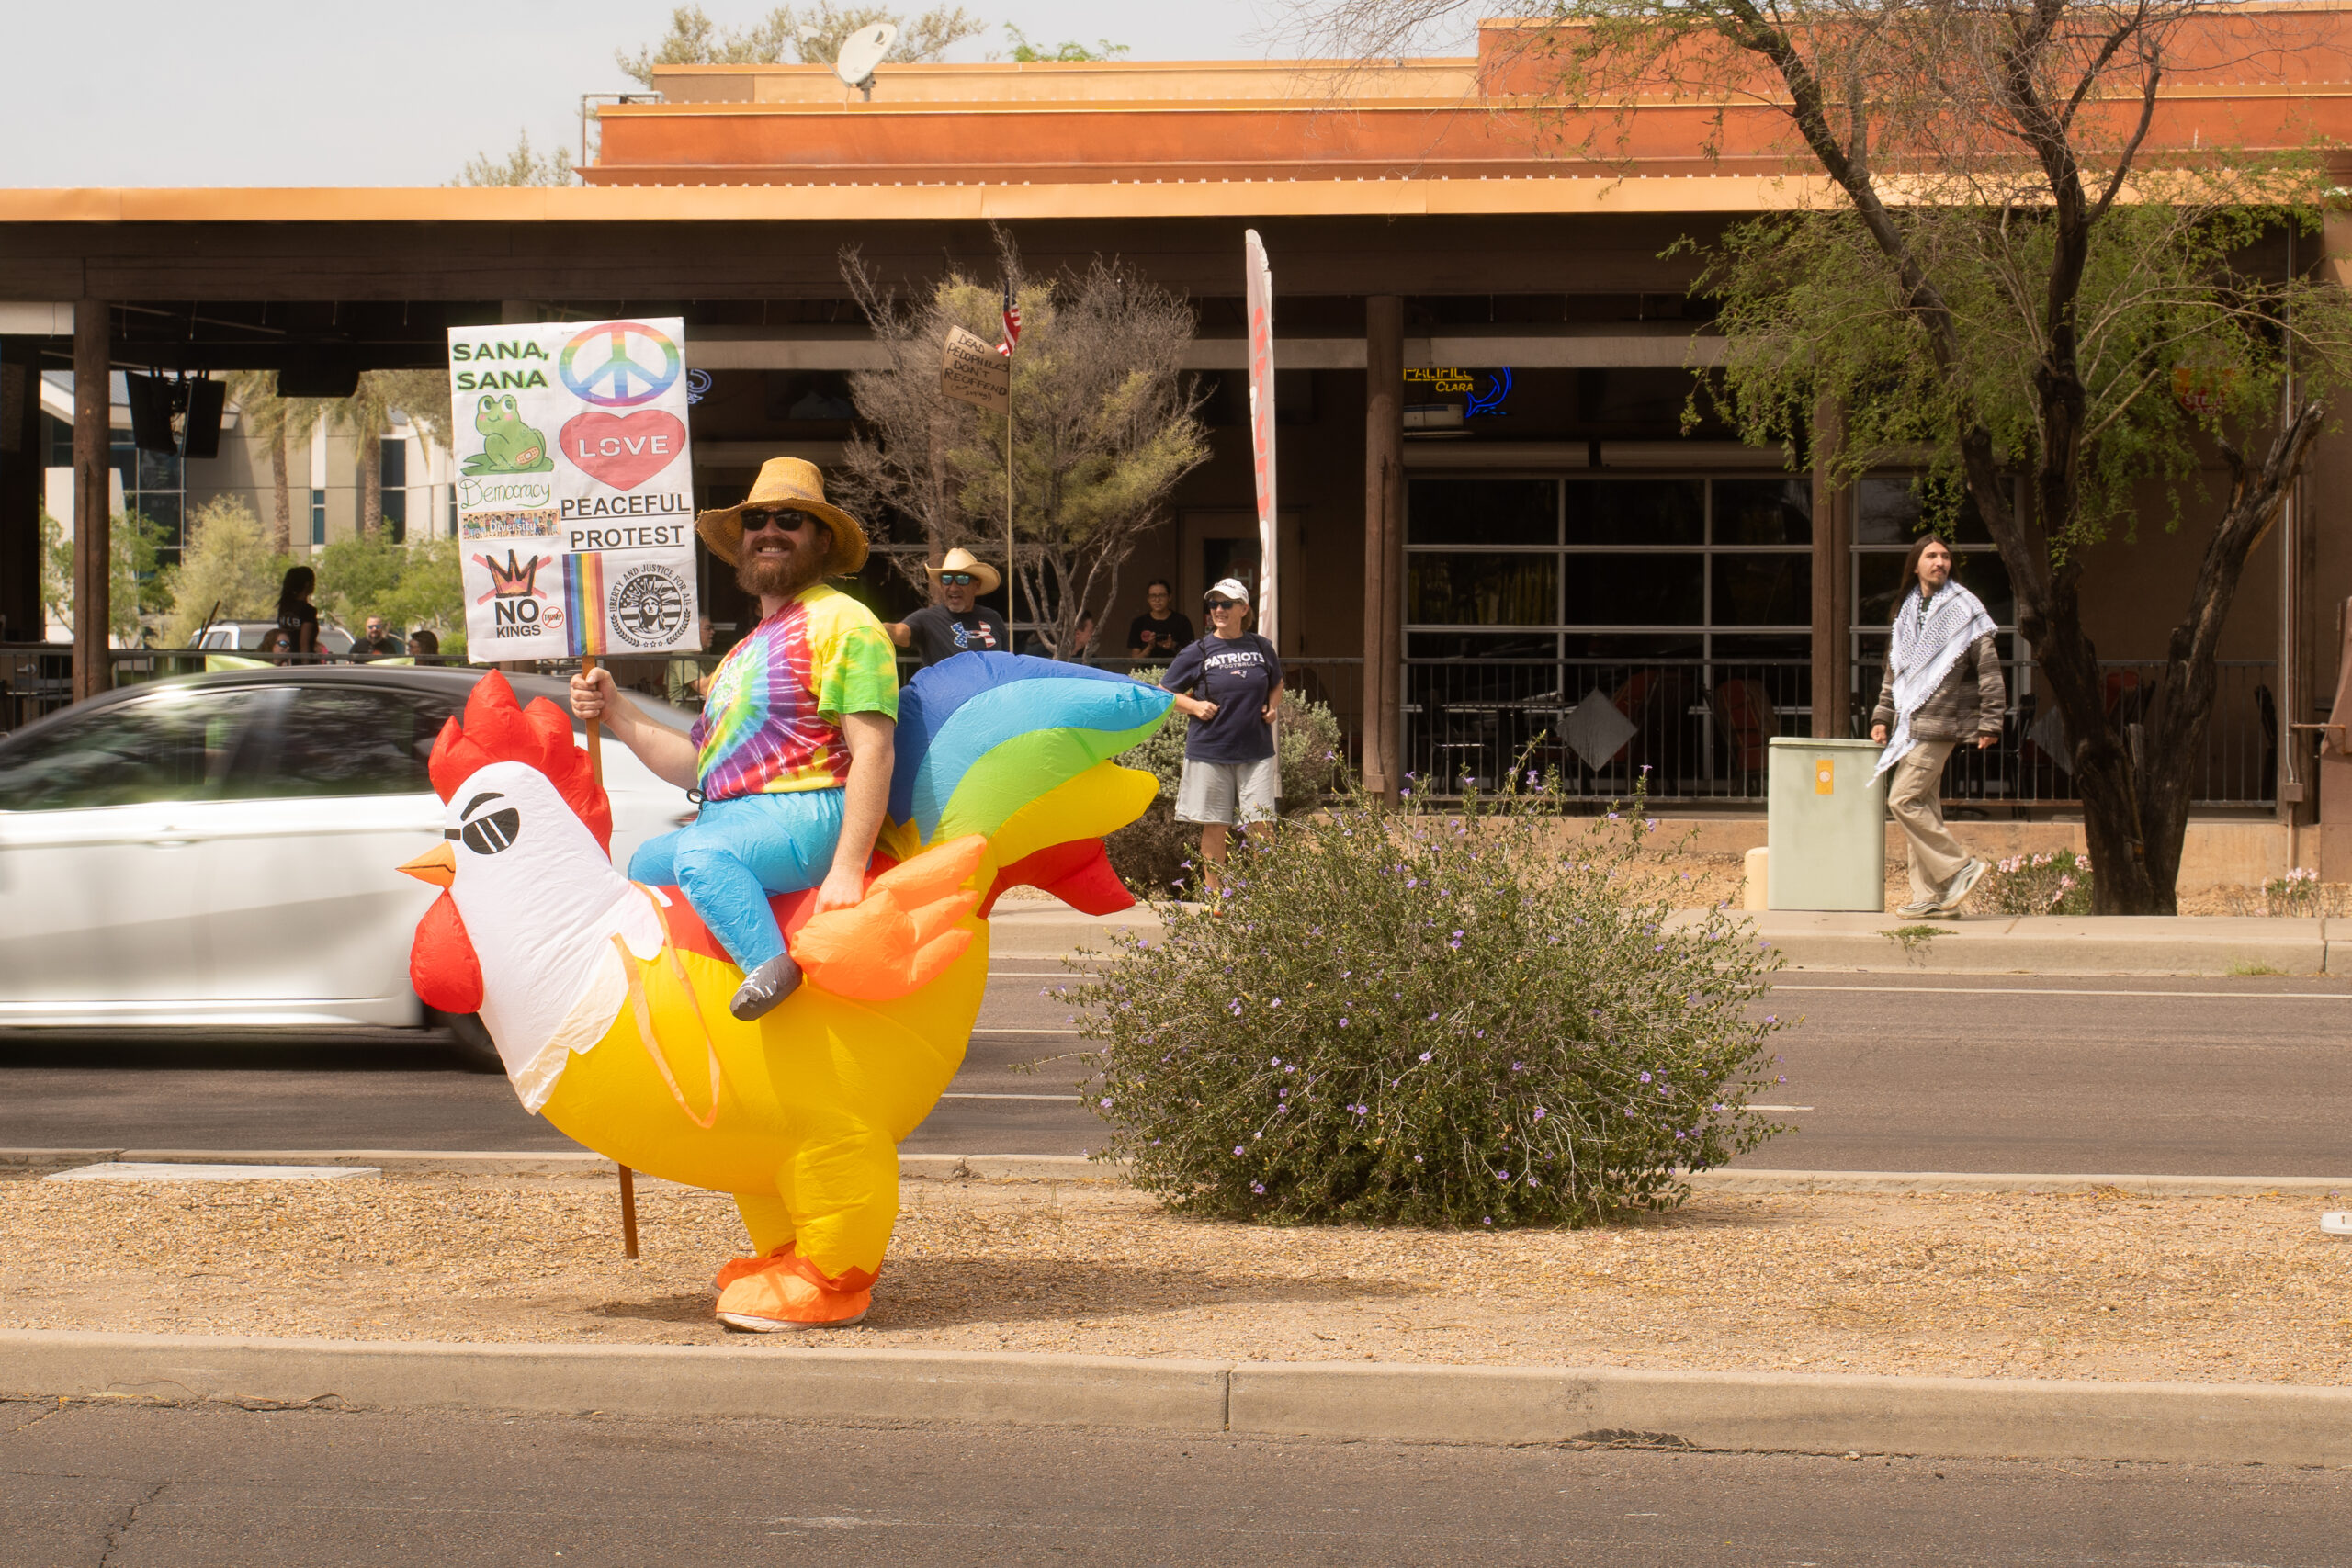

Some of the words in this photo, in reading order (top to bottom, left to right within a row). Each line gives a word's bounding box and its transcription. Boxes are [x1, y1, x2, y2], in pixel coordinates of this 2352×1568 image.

[453, 340, 550, 362] SANA,
[958, 333, 985, 354] DEAD
[947, 342, 1009, 372] PEDOPHILES
[457, 369, 549, 391] SANA
[954, 360, 990, 378] DON'T
[944, 368, 1008, 396] REOFFEND
[579, 435, 670, 458] LOVE
[459, 478, 550, 509] Democracy
[560, 494, 691, 517] PEACEFUL
[490, 521, 537, 533] Diversity
[571, 525, 684, 548] PROTEST
[623, 567, 639, 581] AND
[641, 563, 674, 578] JUSTICE
[673, 575, 687, 591] FOR
[682, 593, 692, 606] ALL
[495, 599, 539, 626] NO
[496, 625, 541, 638] KINGS
[1204, 651, 1265, 671] PATRIOTS
